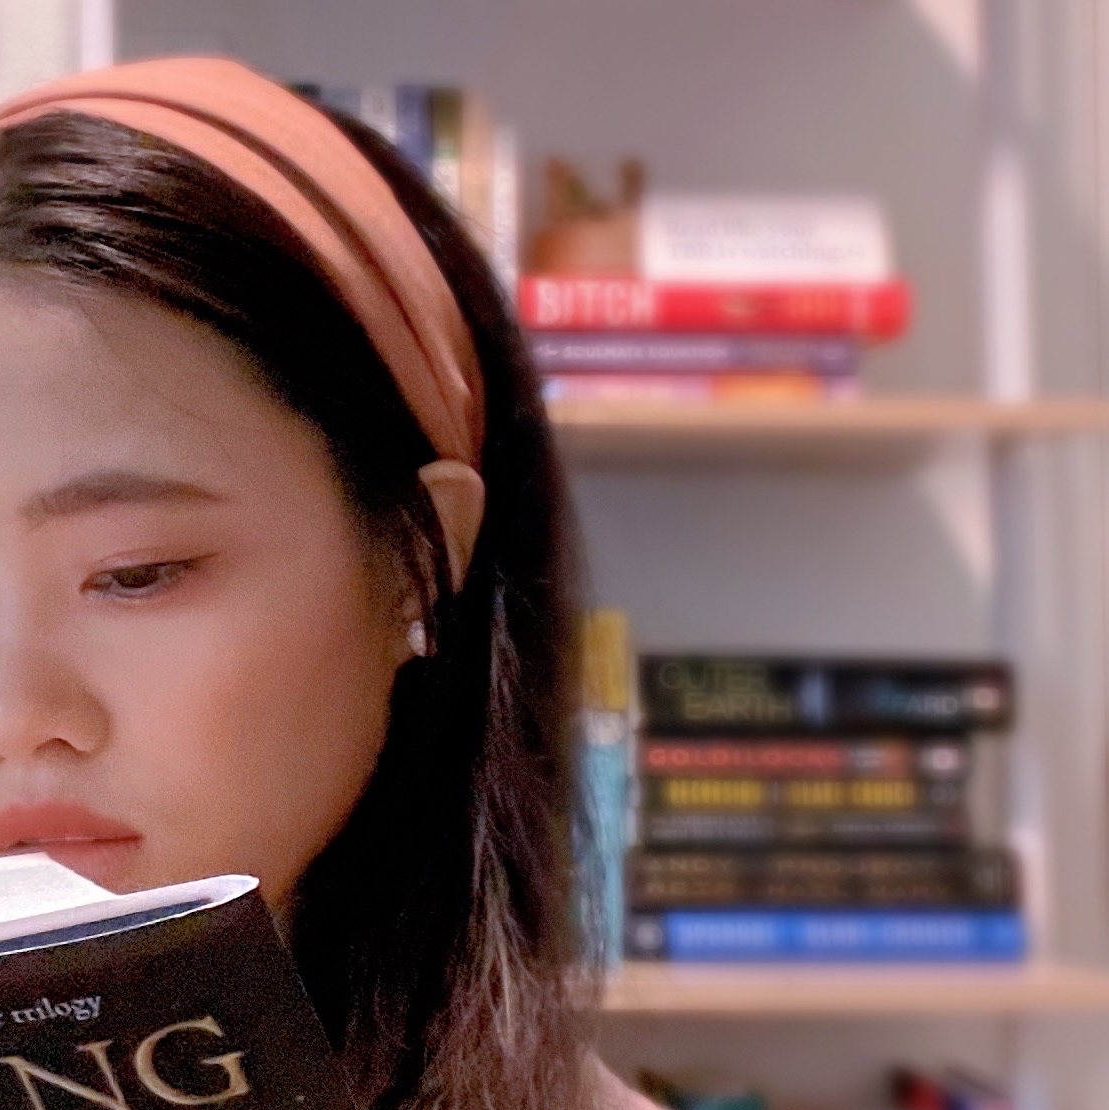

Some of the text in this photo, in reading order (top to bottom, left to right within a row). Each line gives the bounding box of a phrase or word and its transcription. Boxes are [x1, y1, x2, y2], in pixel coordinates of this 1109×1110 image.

[666, 219, 717, 238] Read
[667, 243, 714, 261] TBR
[719, 243, 736, 261] is
[536, 281, 655, 326] BITCH
[563, 345, 644, 360] SOULMATE
[648, 346, 728, 361] EQUATION
[657, 662, 769, 693] OUTER
[683, 693, 793, 722] EARTH
[648, 748, 841, 767] GOLDILOCKS
[643, 858, 736, 874] ANDY
[777, 859, 937, 875] PROJECT
[767, 881, 951, 898] HAIL MARY
[11, 995, 102, 1023] trilogy
